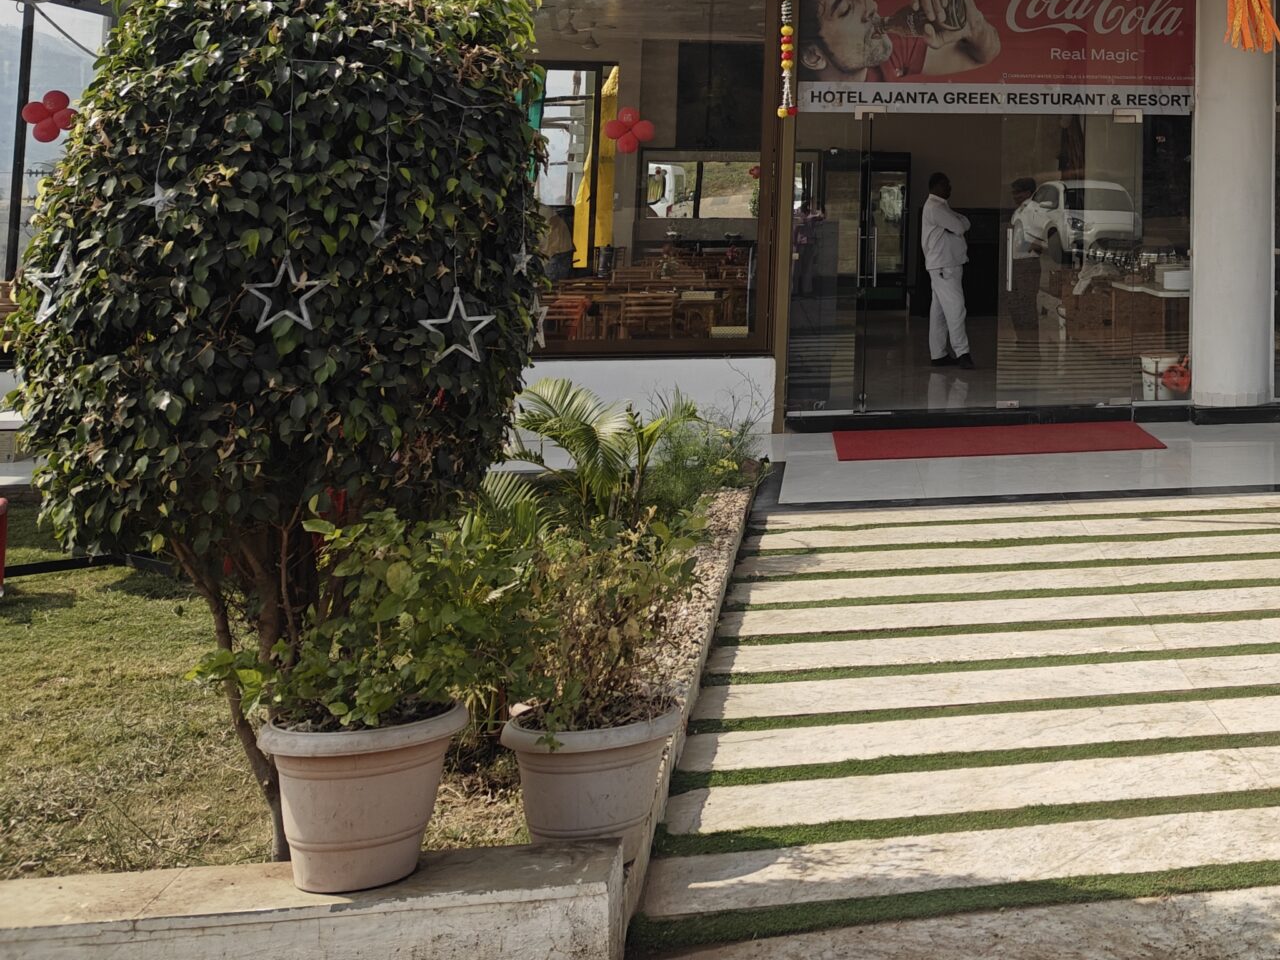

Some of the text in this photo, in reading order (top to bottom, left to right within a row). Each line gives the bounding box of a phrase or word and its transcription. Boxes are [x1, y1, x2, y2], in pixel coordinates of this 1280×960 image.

[1050, 48, 1139, 64] Real Magic
[810, 90, 1191, 108] HOTEL AJANTA GREEN RESTURANT & RESORT
